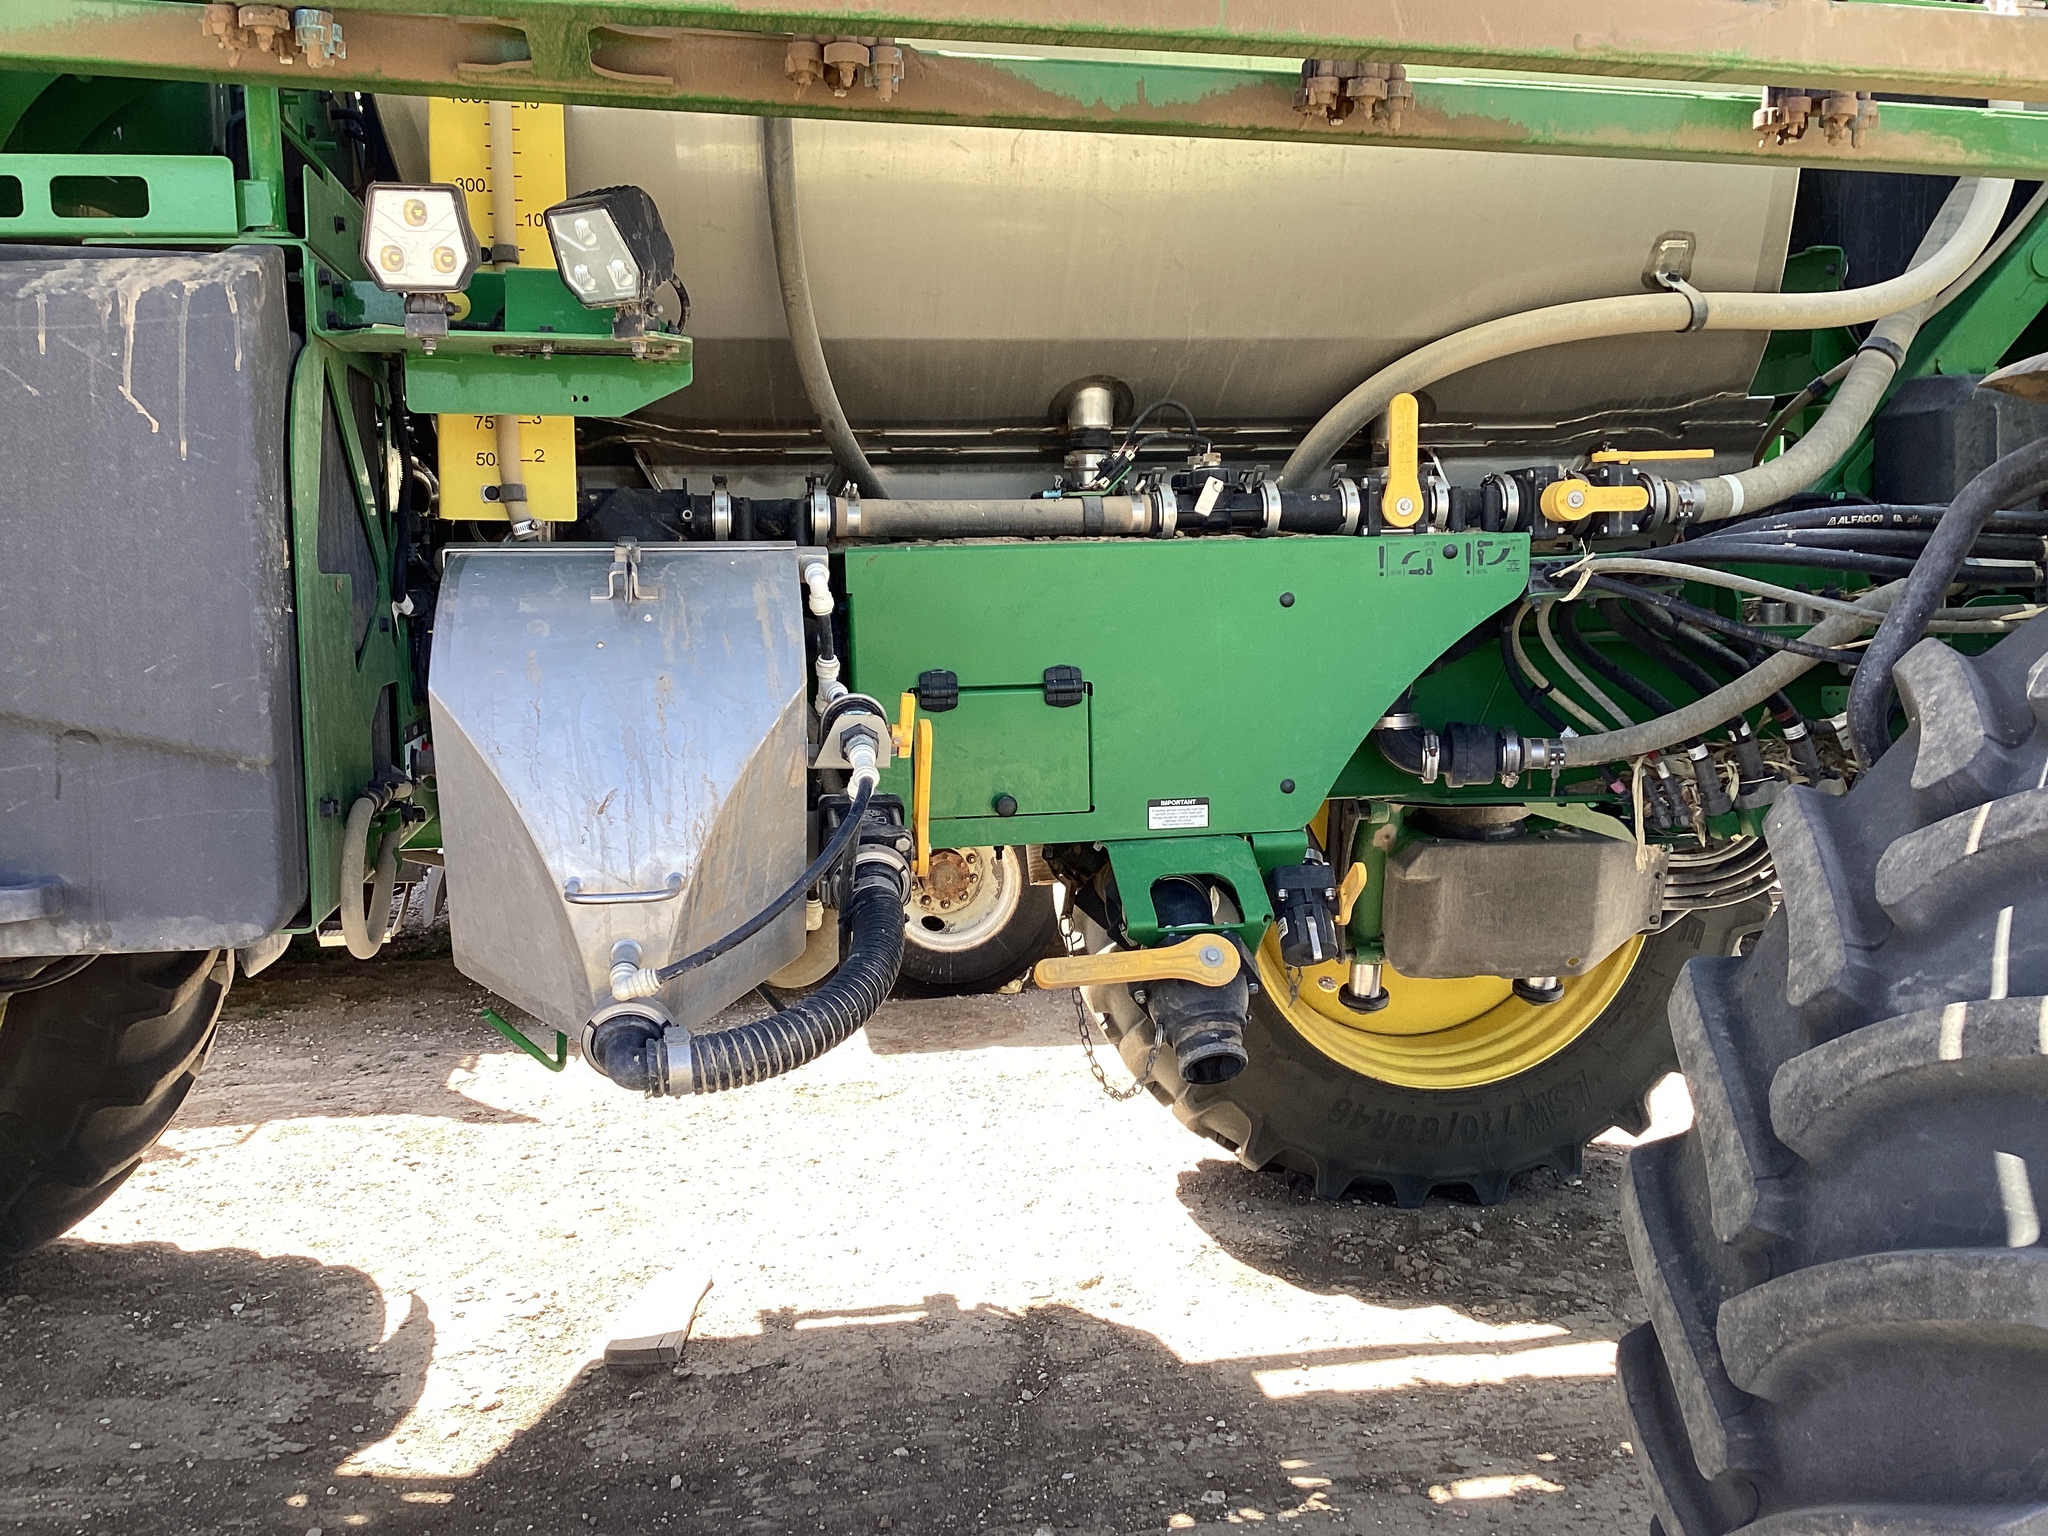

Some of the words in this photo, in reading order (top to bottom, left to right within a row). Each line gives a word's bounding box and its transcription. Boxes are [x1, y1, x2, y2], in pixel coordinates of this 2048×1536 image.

[455, 178, 486, 192] 300
[524, 213, 544, 227] 10
[473, 415, 494, 430] 75
[475, 452, 496, 466] 50
[534, 448, 546, 463] 2
